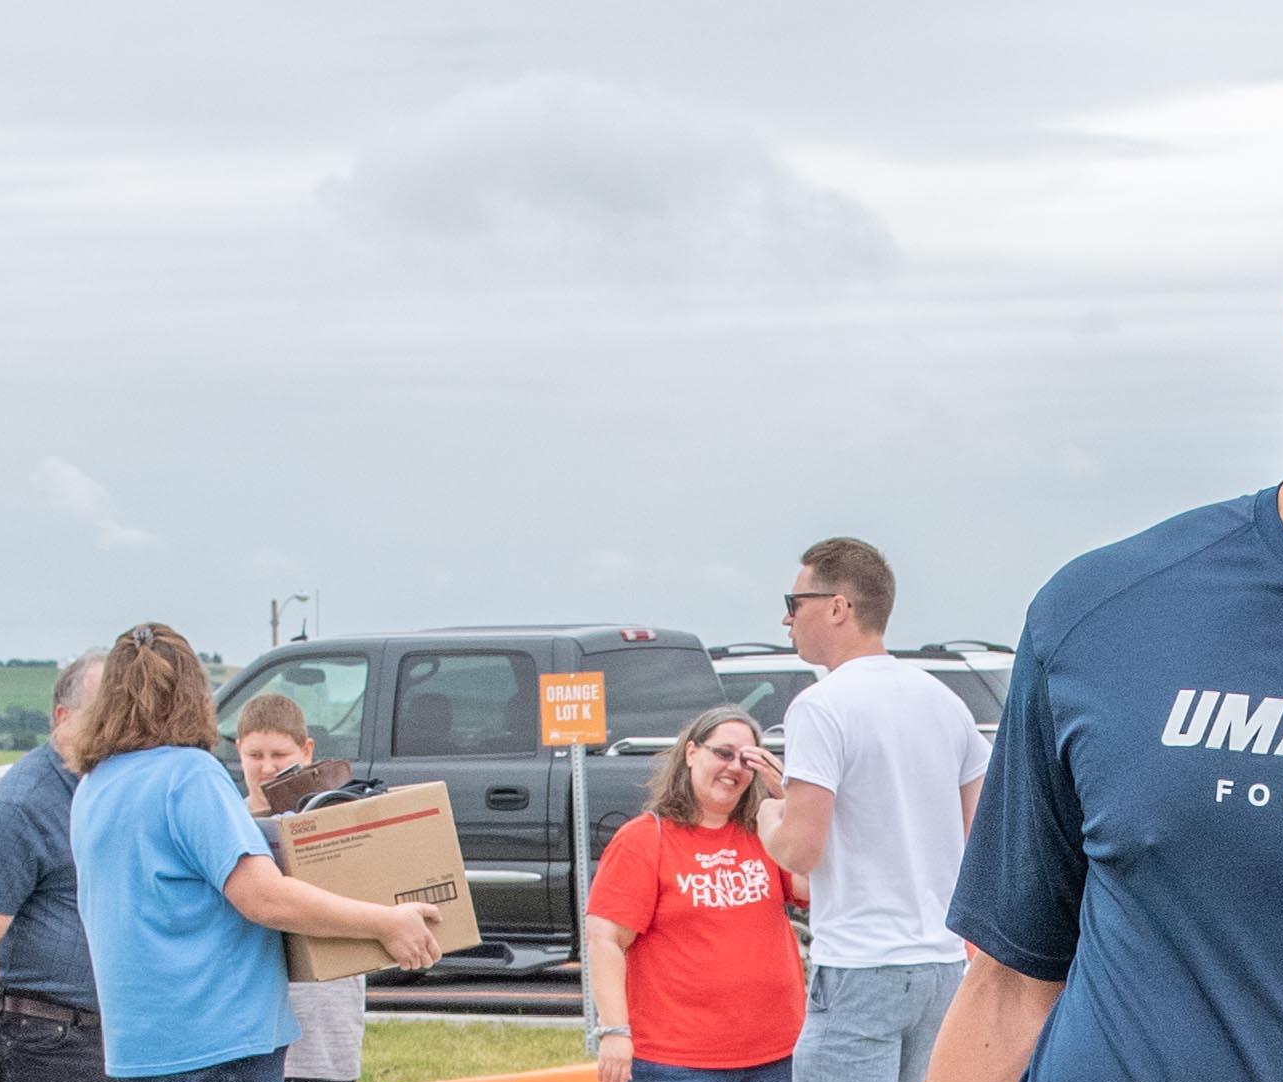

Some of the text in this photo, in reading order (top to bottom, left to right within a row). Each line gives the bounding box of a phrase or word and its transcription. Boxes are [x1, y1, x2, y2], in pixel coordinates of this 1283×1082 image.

[546, 683, 600, 703] ORANGE
[555, 703, 593, 721] LOT K
